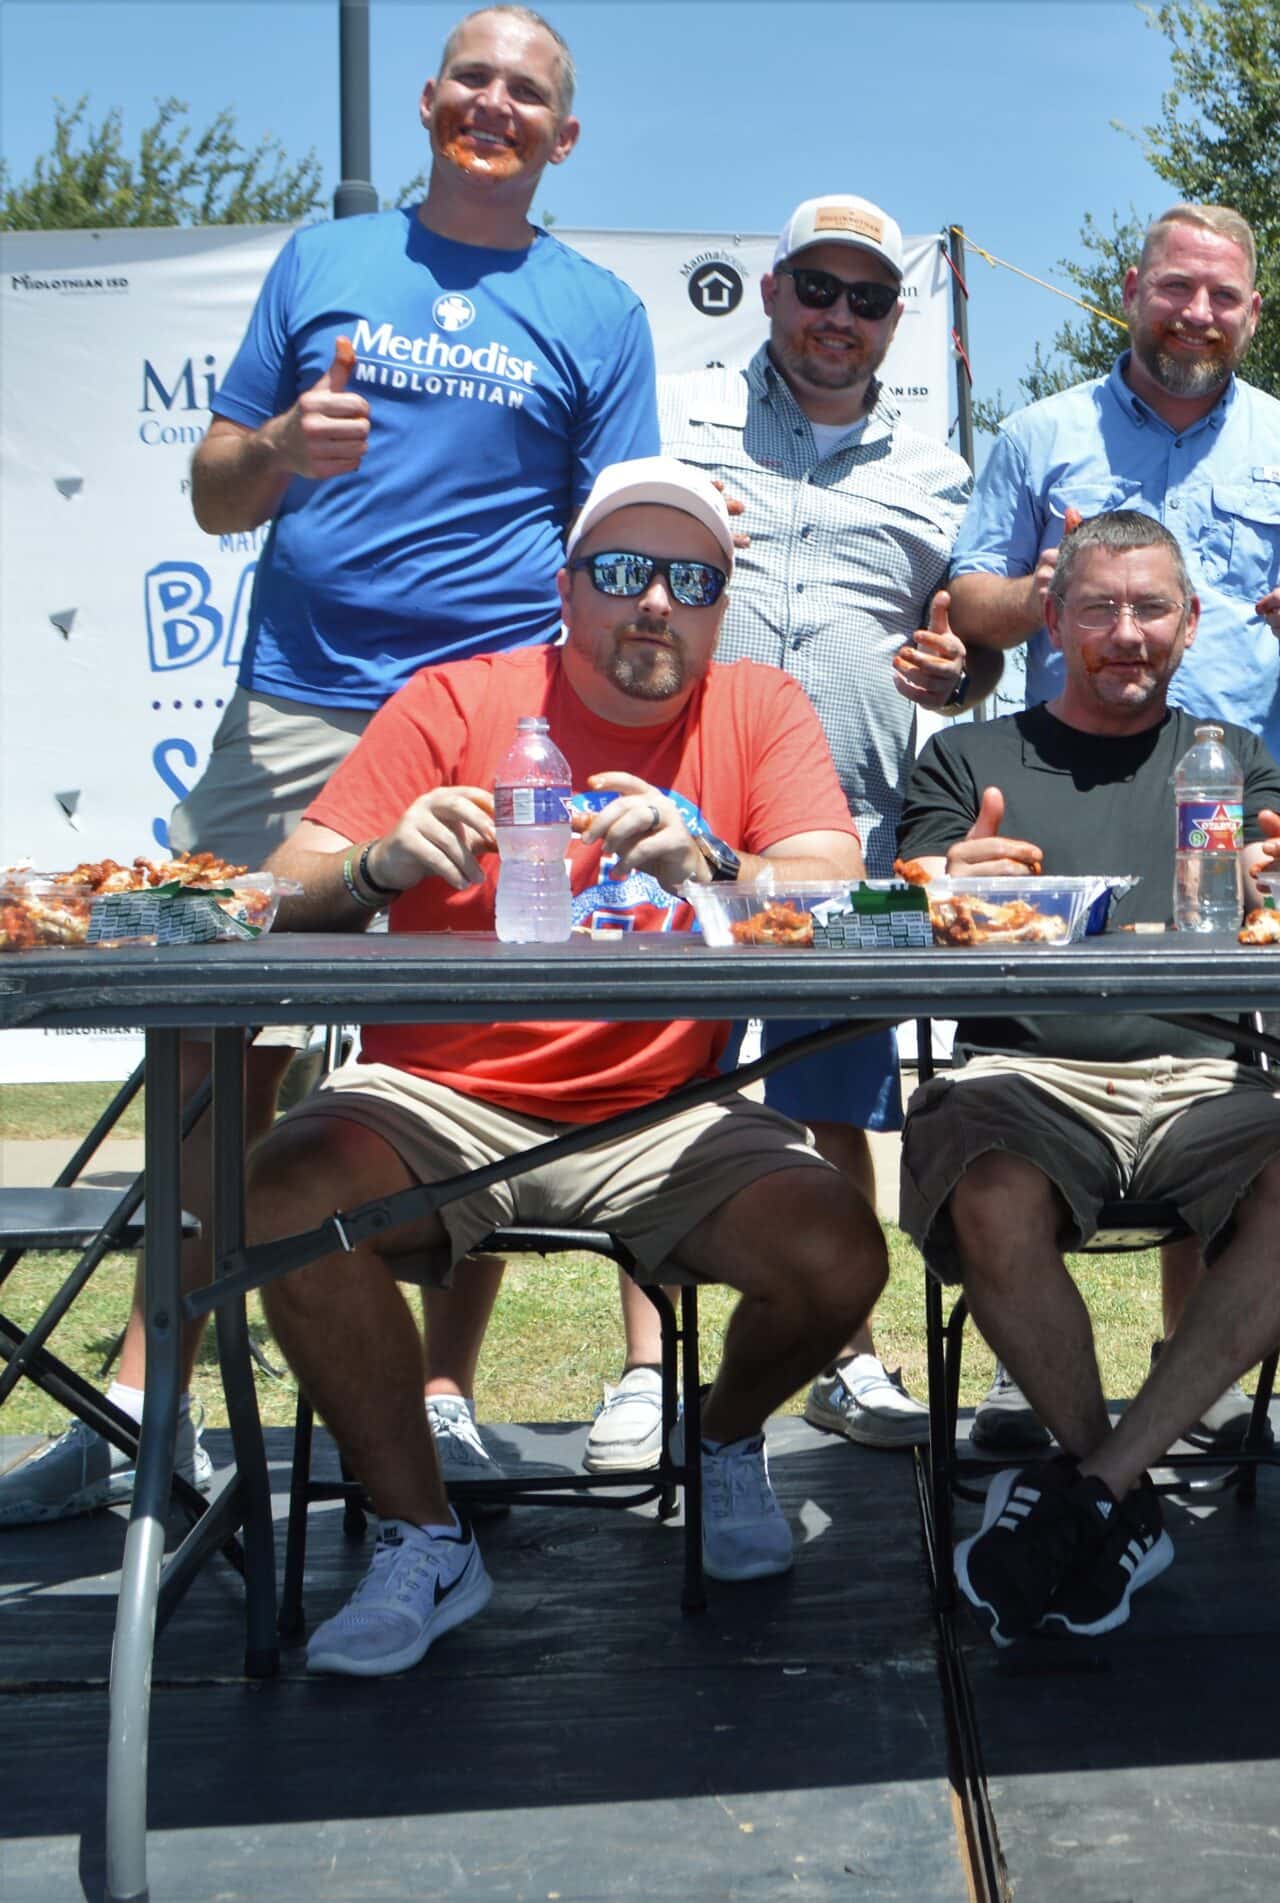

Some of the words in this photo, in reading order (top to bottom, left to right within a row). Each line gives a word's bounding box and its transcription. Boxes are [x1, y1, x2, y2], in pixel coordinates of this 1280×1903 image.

[353, 319, 538, 386] Methodist
[355, 363, 524, 410] MIDLOTHIAN
[907, 386, 929, 397] ISD
